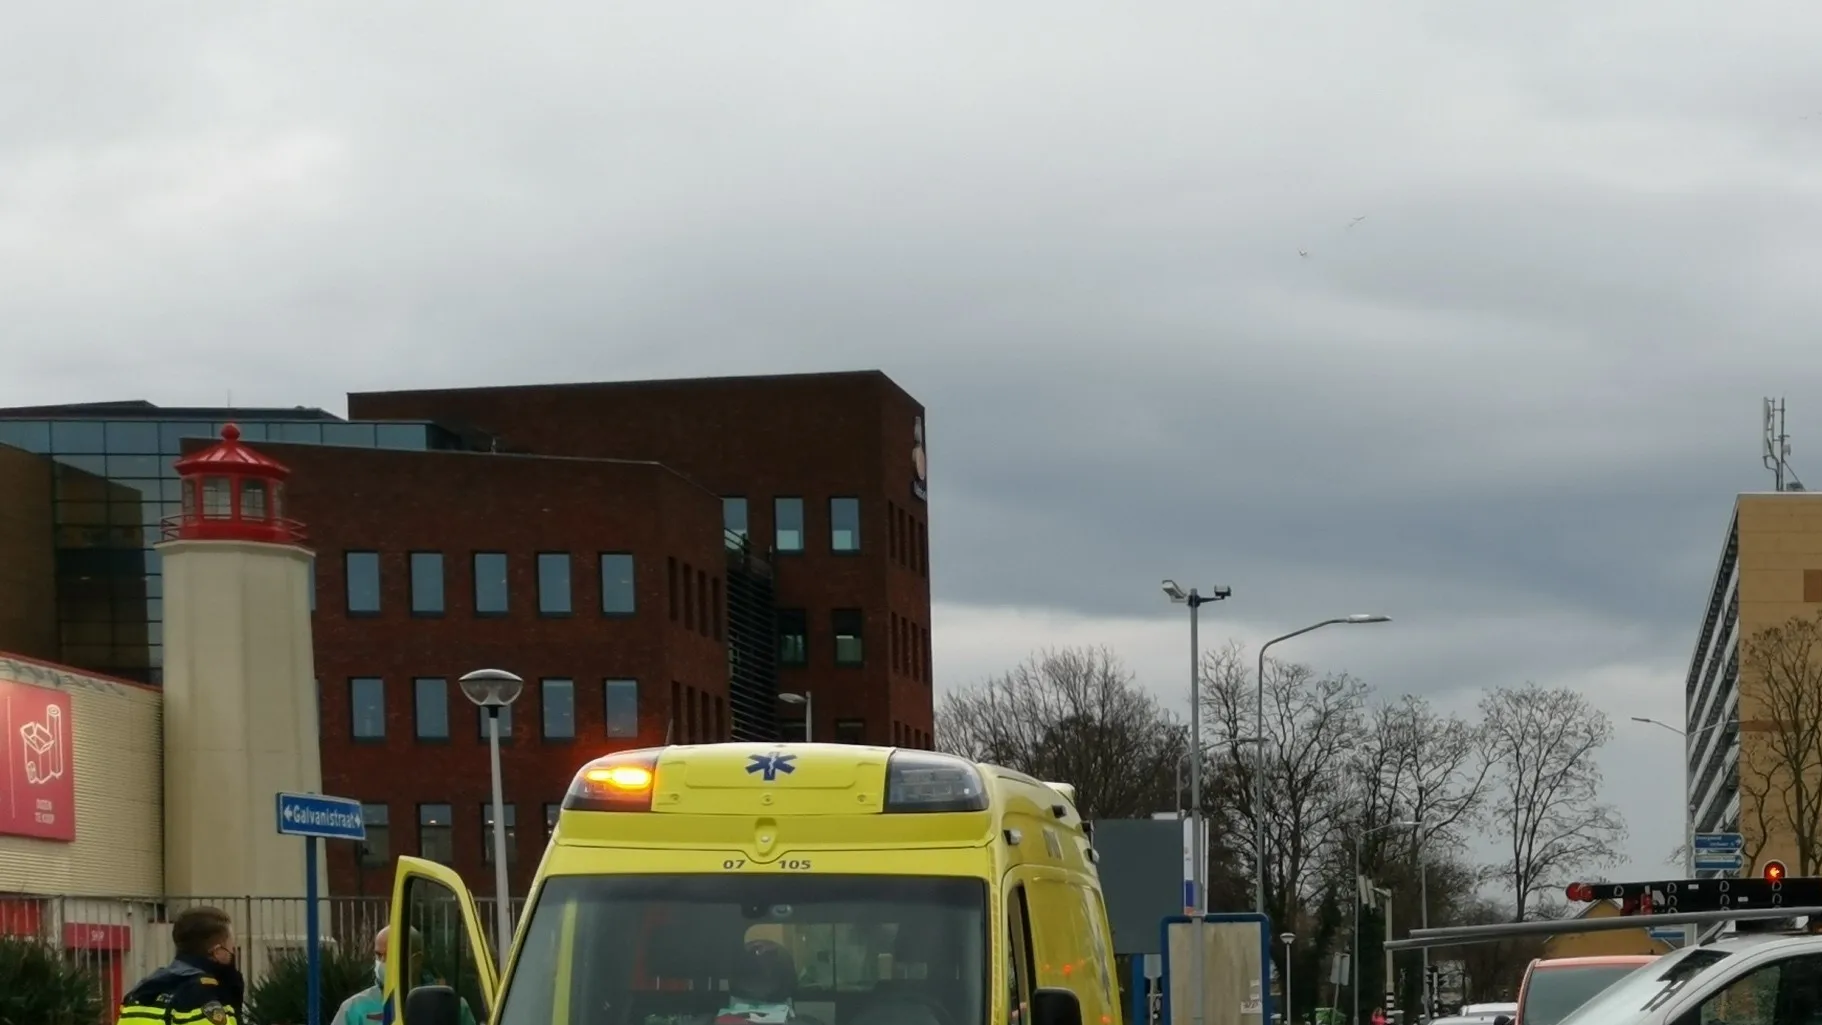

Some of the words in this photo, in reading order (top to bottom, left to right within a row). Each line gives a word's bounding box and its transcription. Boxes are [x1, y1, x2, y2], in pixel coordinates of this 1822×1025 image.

[293, 804, 357, 829] Galvanistraat
[723, 859, 746, 870] 07
[778, 859, 812, 870] 105
